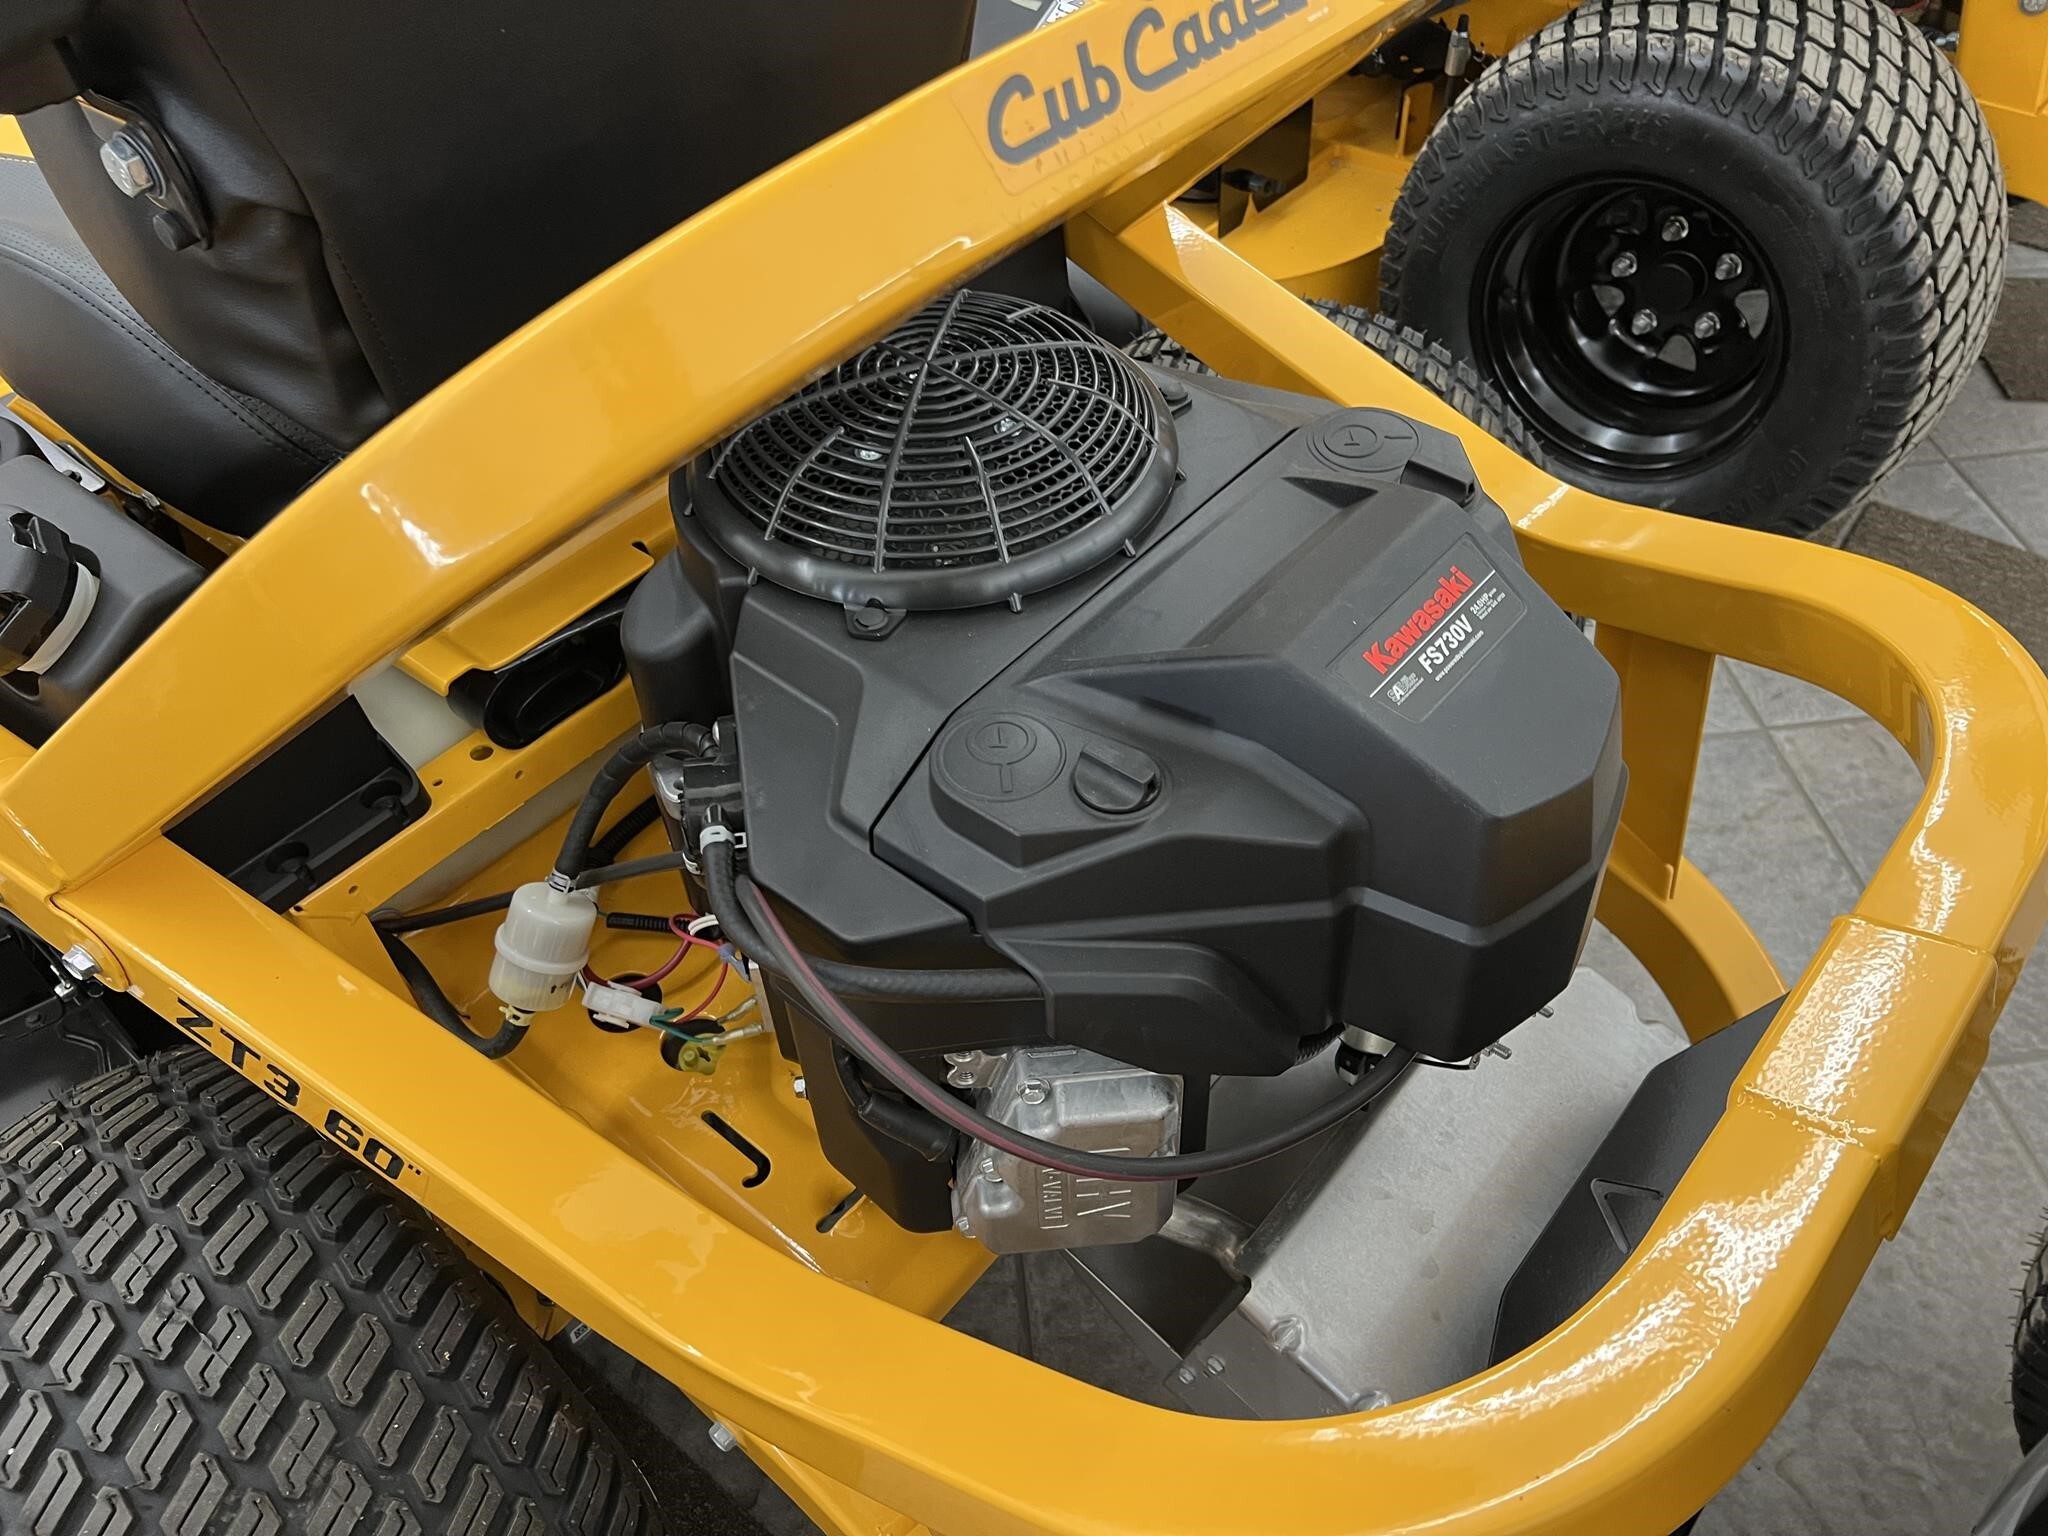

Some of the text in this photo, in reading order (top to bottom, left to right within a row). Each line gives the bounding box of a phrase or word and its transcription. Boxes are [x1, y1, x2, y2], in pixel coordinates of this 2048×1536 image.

[988, 40, 1121, 165] Cub
[1362, 565, 1474, 675] Kawasaki
[1418, 613, 1473, 674] FS730V
[176, 997, 301, 1107] ZT3
